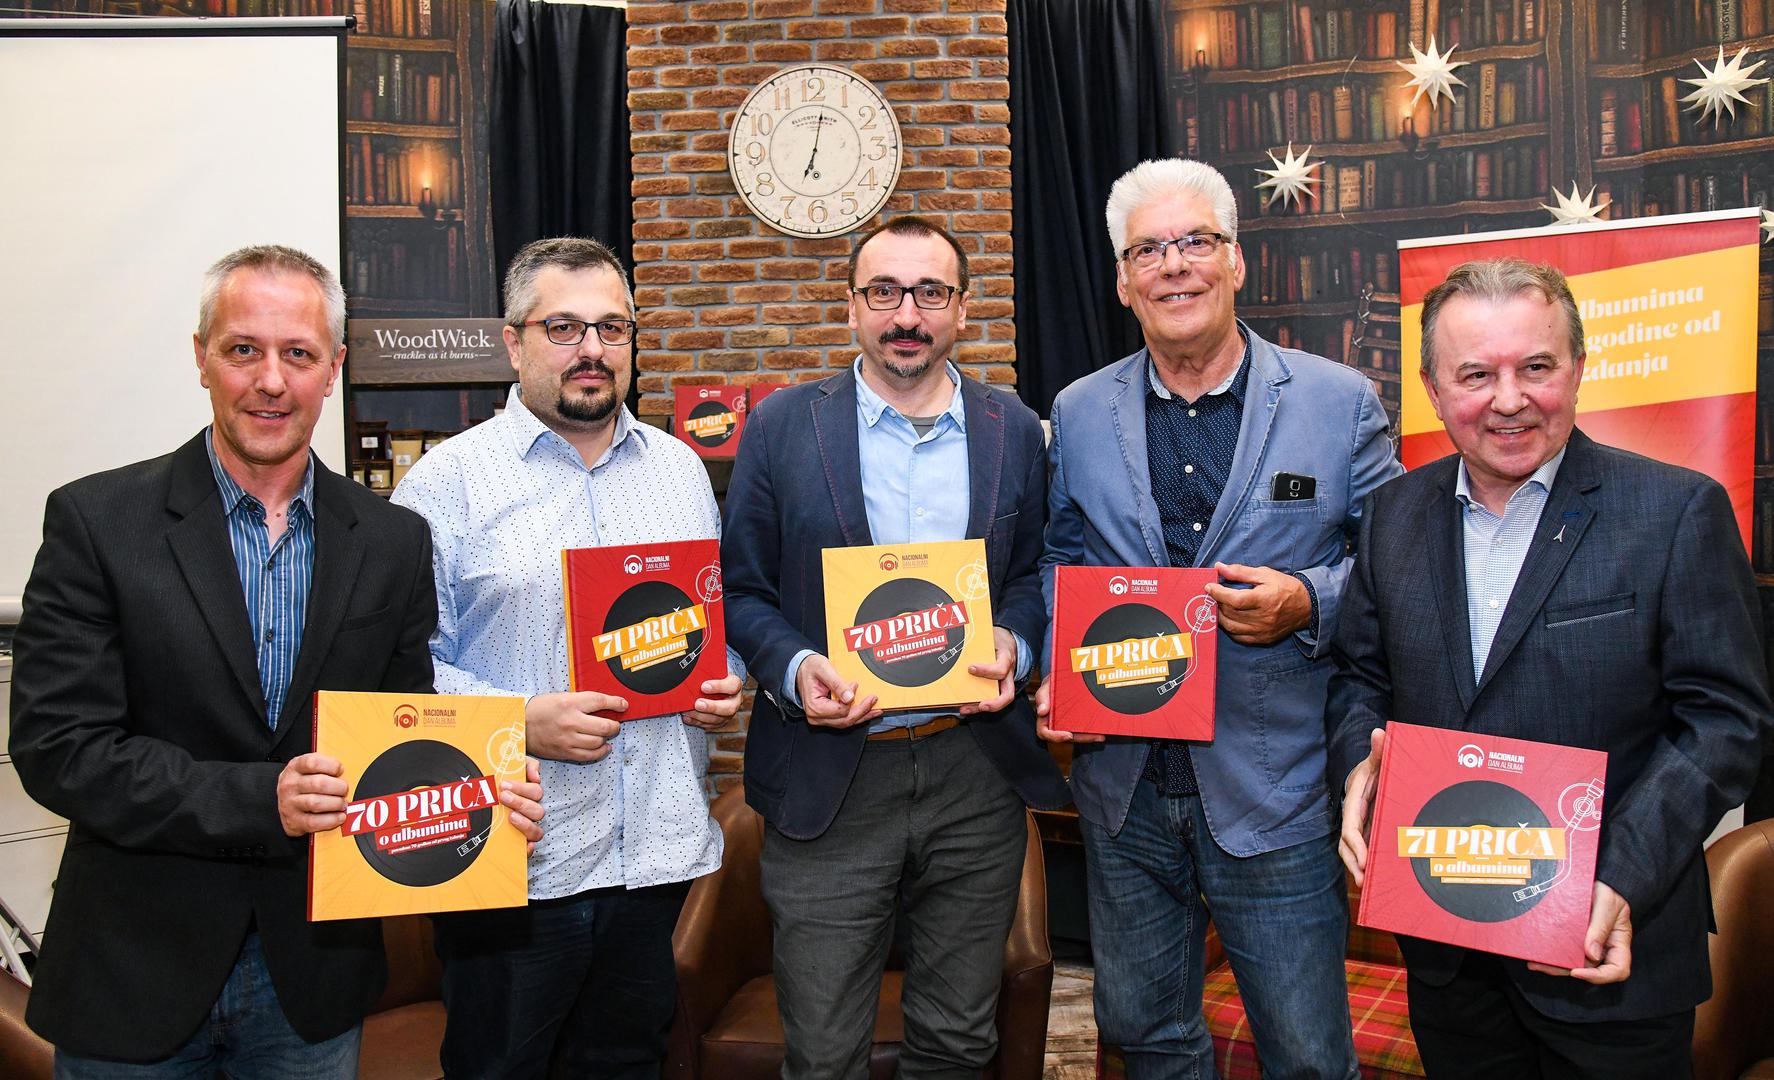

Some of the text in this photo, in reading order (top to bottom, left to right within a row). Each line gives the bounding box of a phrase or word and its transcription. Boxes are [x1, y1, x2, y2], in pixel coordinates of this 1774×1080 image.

[774, 86, 791, 111] 11
[801, 77, 826, 103] 12
[841, 84, 849, 108] 1
[750, 112, 774, 137] 10
[858, 105, 878, 130] 2
[745, 141, 766, 167] 9
[867, 136, 888, 161] 3
[755, 172, 776, 196] 8
[857, 167, 878, 191] 4
[780, 195, 796, 220] 7
[807, 200, 828, 224] 6
[840, 191, 859, 215] 5
[1579, 286, 1704, 321] lbumima
[1586, 310, 1721, 353] godine od
[393, 350, 474, 360] crackles as it burns
[1581, 352, 1668, 382] zdanja
[901, 553, 928, 561] NACIONALNI
[598, 606, 700, 658] 71 PRIČA
[850, 602, 967, 649] 70 PRIČA
[623, 657, 631, 665] o
[633, 641, 686, 663] albumima
[876, 649, 884, 658] o
[885, 634, 945, 656] albumima
[1076, 631, 1185, 669] 71 PRIČA
[1099, 665, 1167, 681] o albumima
[423, 709, 456, 717] NACIONALNI
[1487, 759, 1524, 771] DAN ALBUMA
[1489, 751, 1525, 764] NACIONALNI
[346, 774, 496, 832] 70 PRIČA
[379, 817, 468, 846] o albumima
[1405, 821, 1556, 858] 71 PRIČA
[1433, 861, 1528, 875] o albumima
